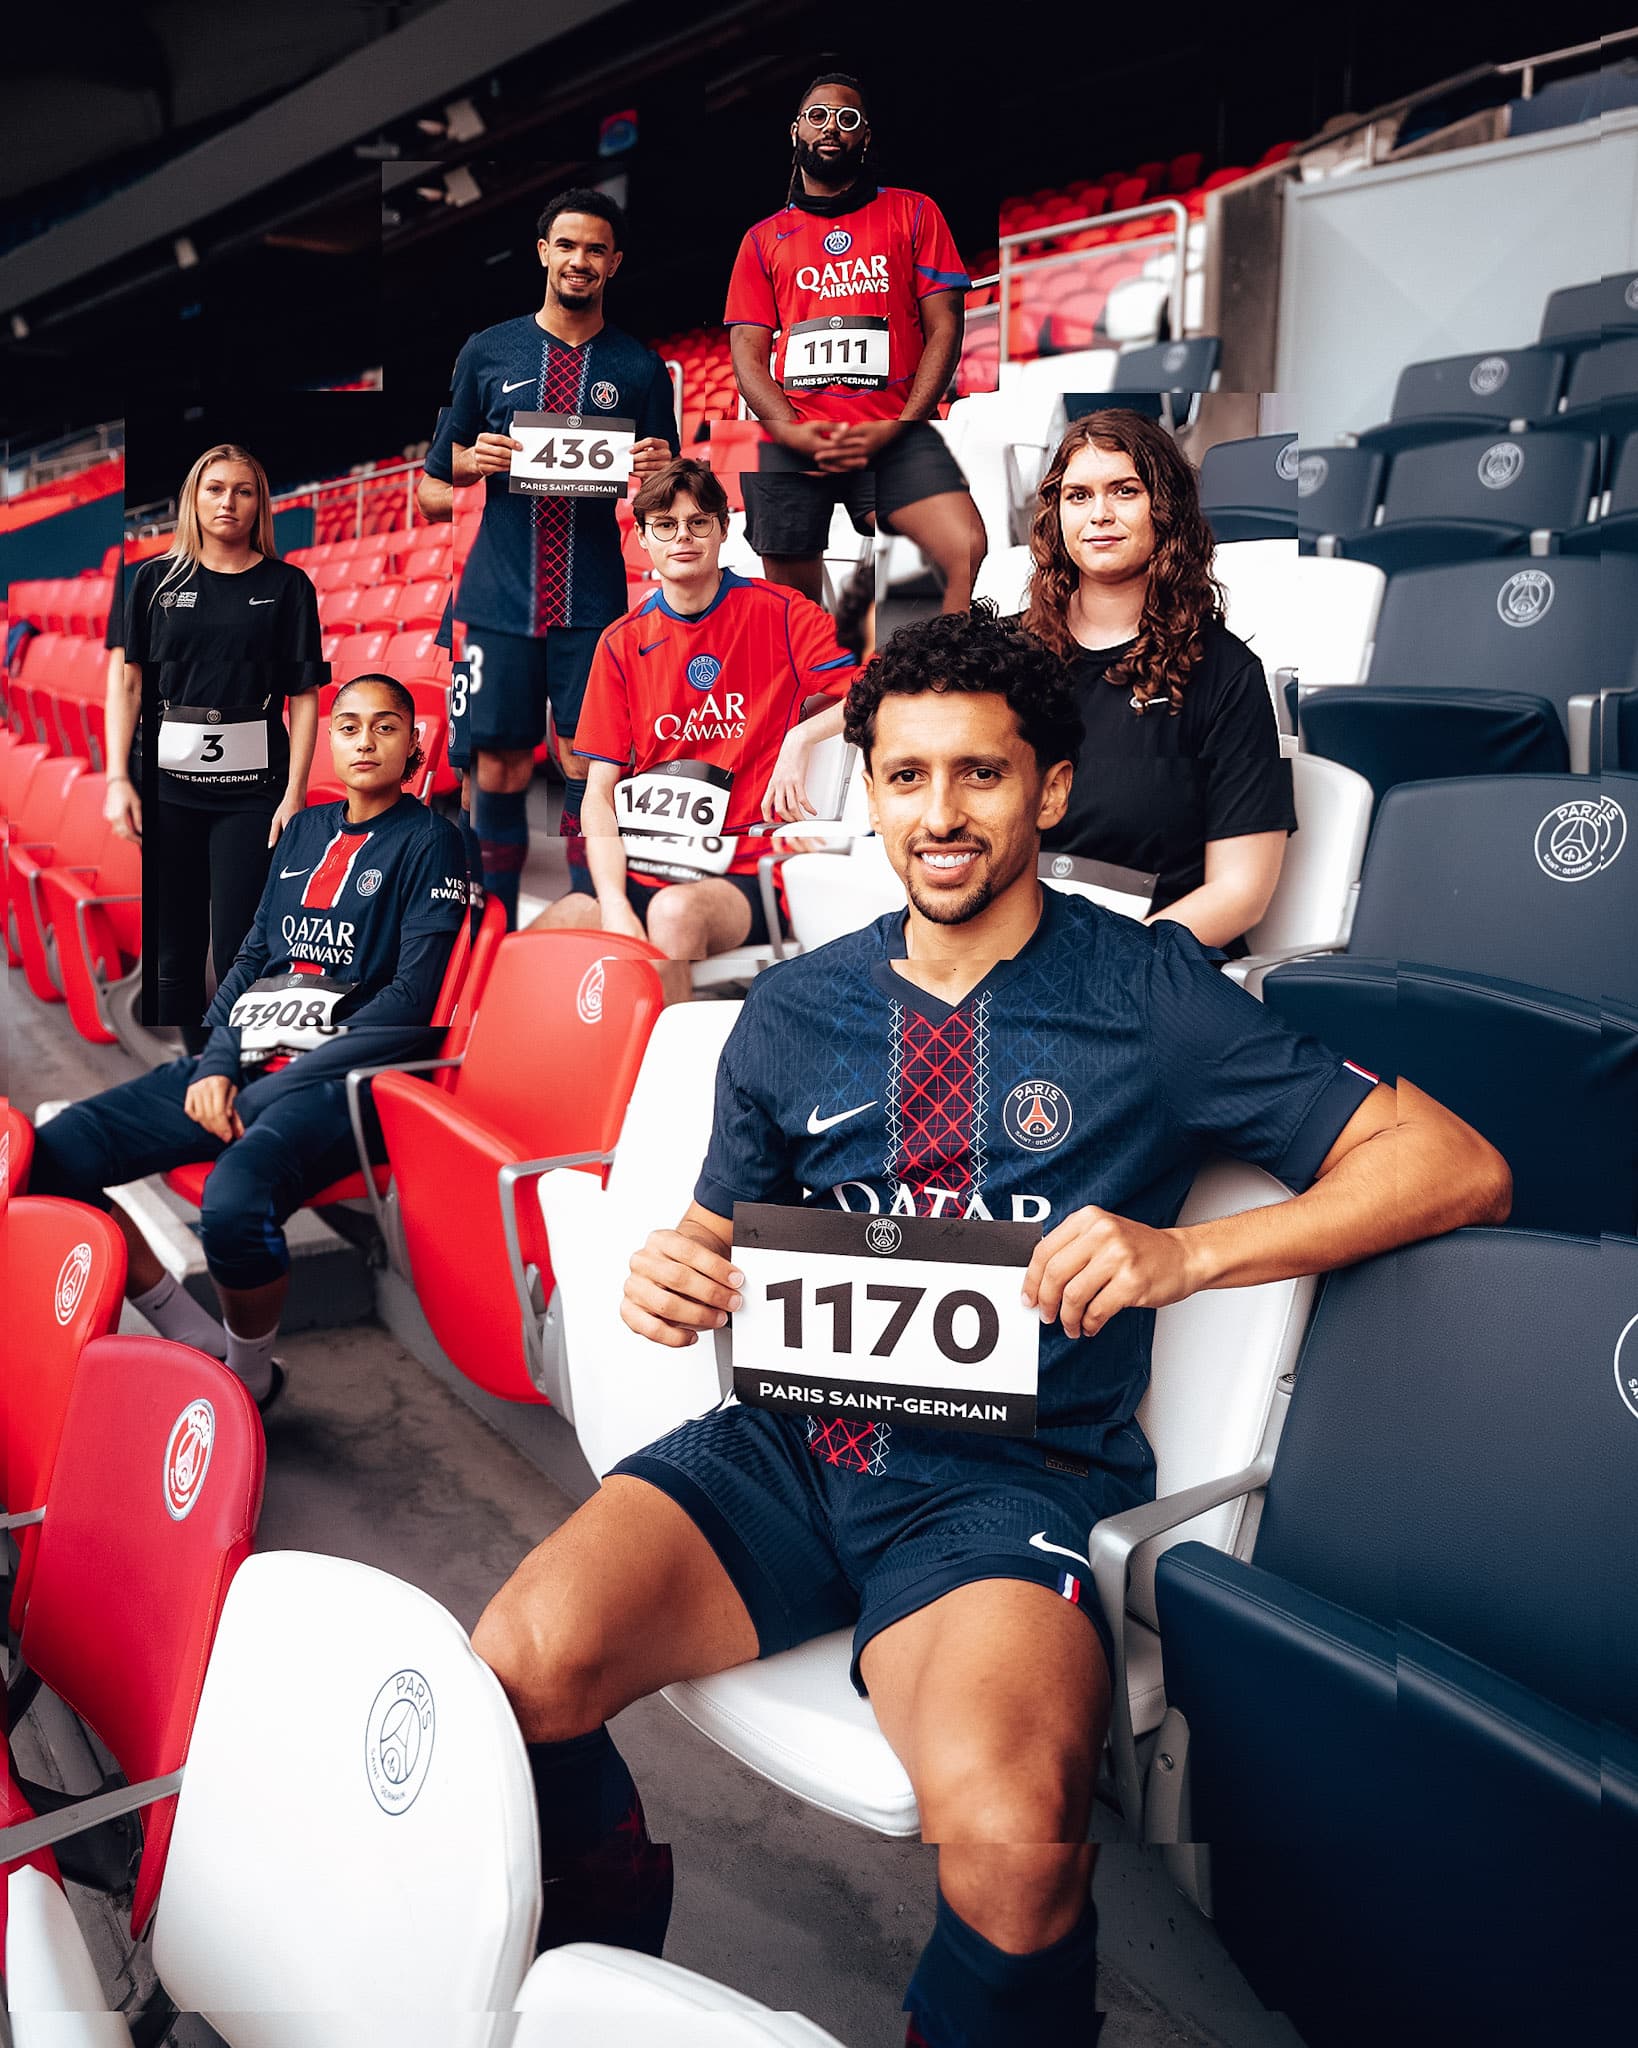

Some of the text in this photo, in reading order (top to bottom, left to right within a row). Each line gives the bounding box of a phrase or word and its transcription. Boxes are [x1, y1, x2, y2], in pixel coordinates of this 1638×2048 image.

[796, 255, 889, 293] QATAR
[819, 277, 889, 300] AIRWAYS
[804, 338, 868, 365] 1111
[792, 378, 816, 387] PARIS
[531, 437, 614, 470] 436
[520, 481, 618, 493] PARIS SAINT-GERMAIN
[200, 734, 225, 763] 3
[190, 773, 259, 783] SAINT-GERMAIN
[620, 784, 715, 826] 14216
[282, 915, 355, 948] QATAR
[287, 942, 353, 965] AIRWAYS
[230, 1000, 324, 1026] 13908
[1013, 1083, 1061, 1101] PARIS
[766, 1278, 1000, 1364] 1170
[759, 1382, 1008, 1421] PARIS SAINT-GERMAIN
[396, 1675, 432, 1731] PARIS
